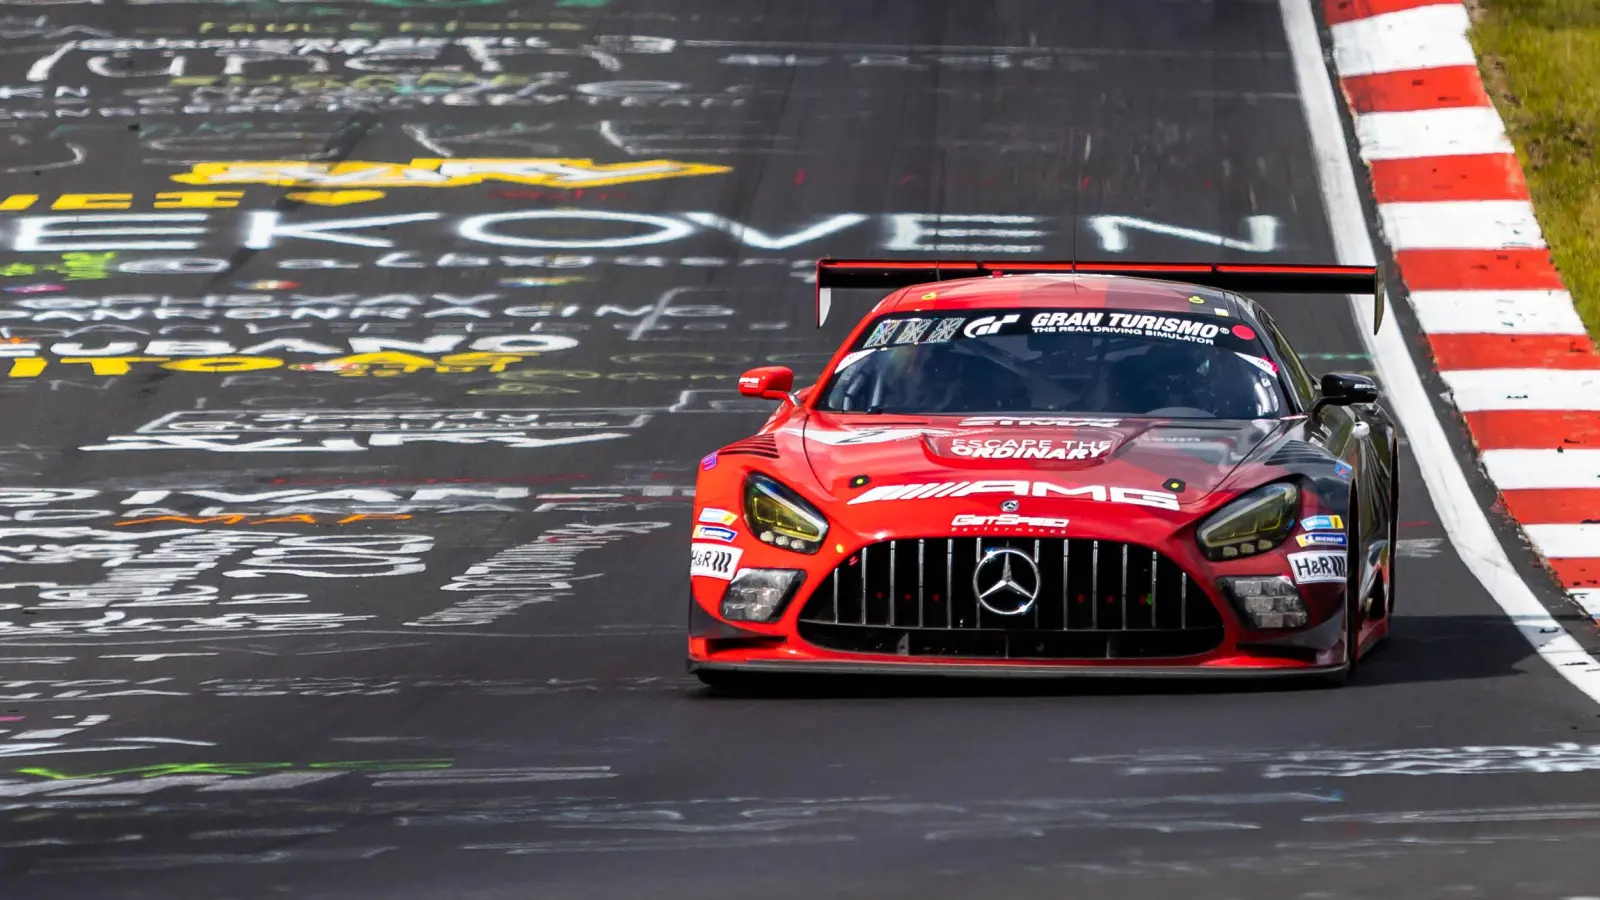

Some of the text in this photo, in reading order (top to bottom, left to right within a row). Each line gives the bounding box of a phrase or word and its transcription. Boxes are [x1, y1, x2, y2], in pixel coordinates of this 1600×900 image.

[1031, 312, 1220, 339] GRAN TURISMO
[1032, 326, 1214, 346] THE REAL DRIVING SIMULATOR
[951, 446, 1111, 460] ORDINARY
[952, 438, 1113, 450] ESCAPE THE
[949, 480, 1180, 511] AMG
